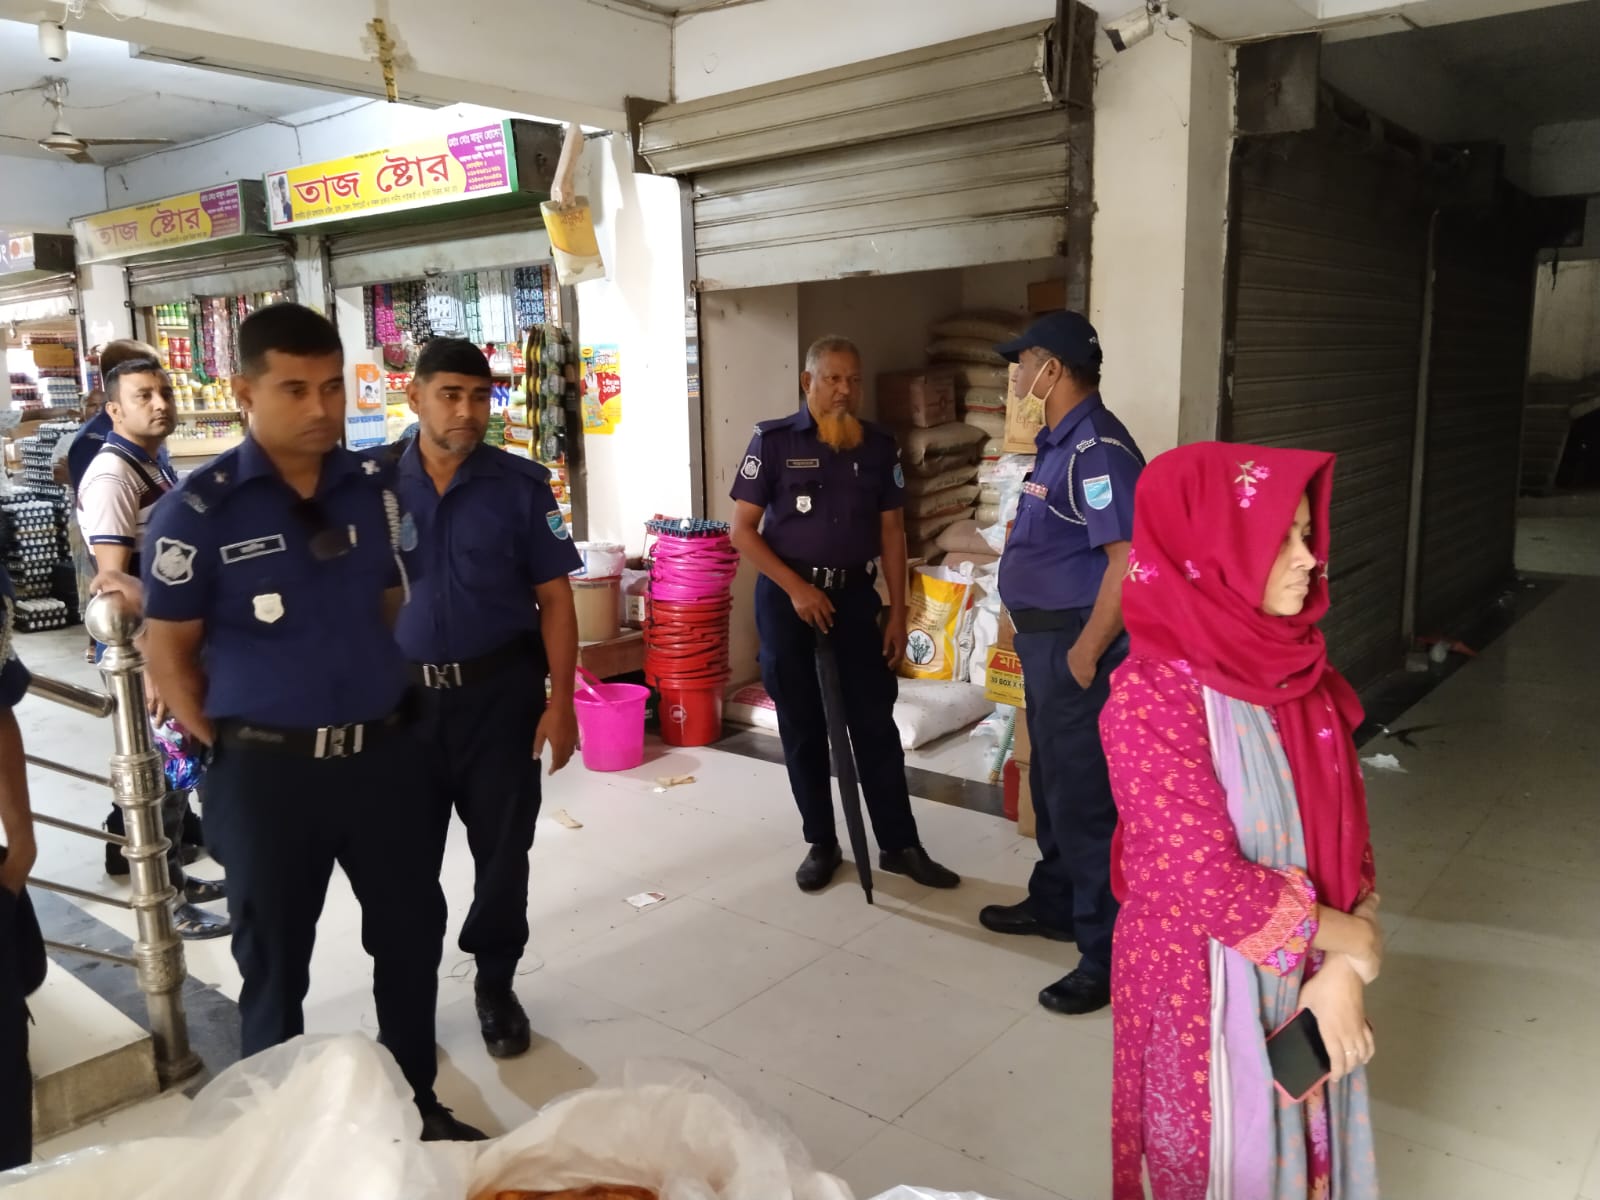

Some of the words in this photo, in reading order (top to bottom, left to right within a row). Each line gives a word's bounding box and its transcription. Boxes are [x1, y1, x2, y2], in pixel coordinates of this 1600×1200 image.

[294, 172, 360, 204] তাজ
[377, 154, 449, 192] ষ্টোর
[95, 221, 138, 245] তাজ
[151, 208, 200, 237] ষ্টোর
[999, 678, 1011, 687] BOX
